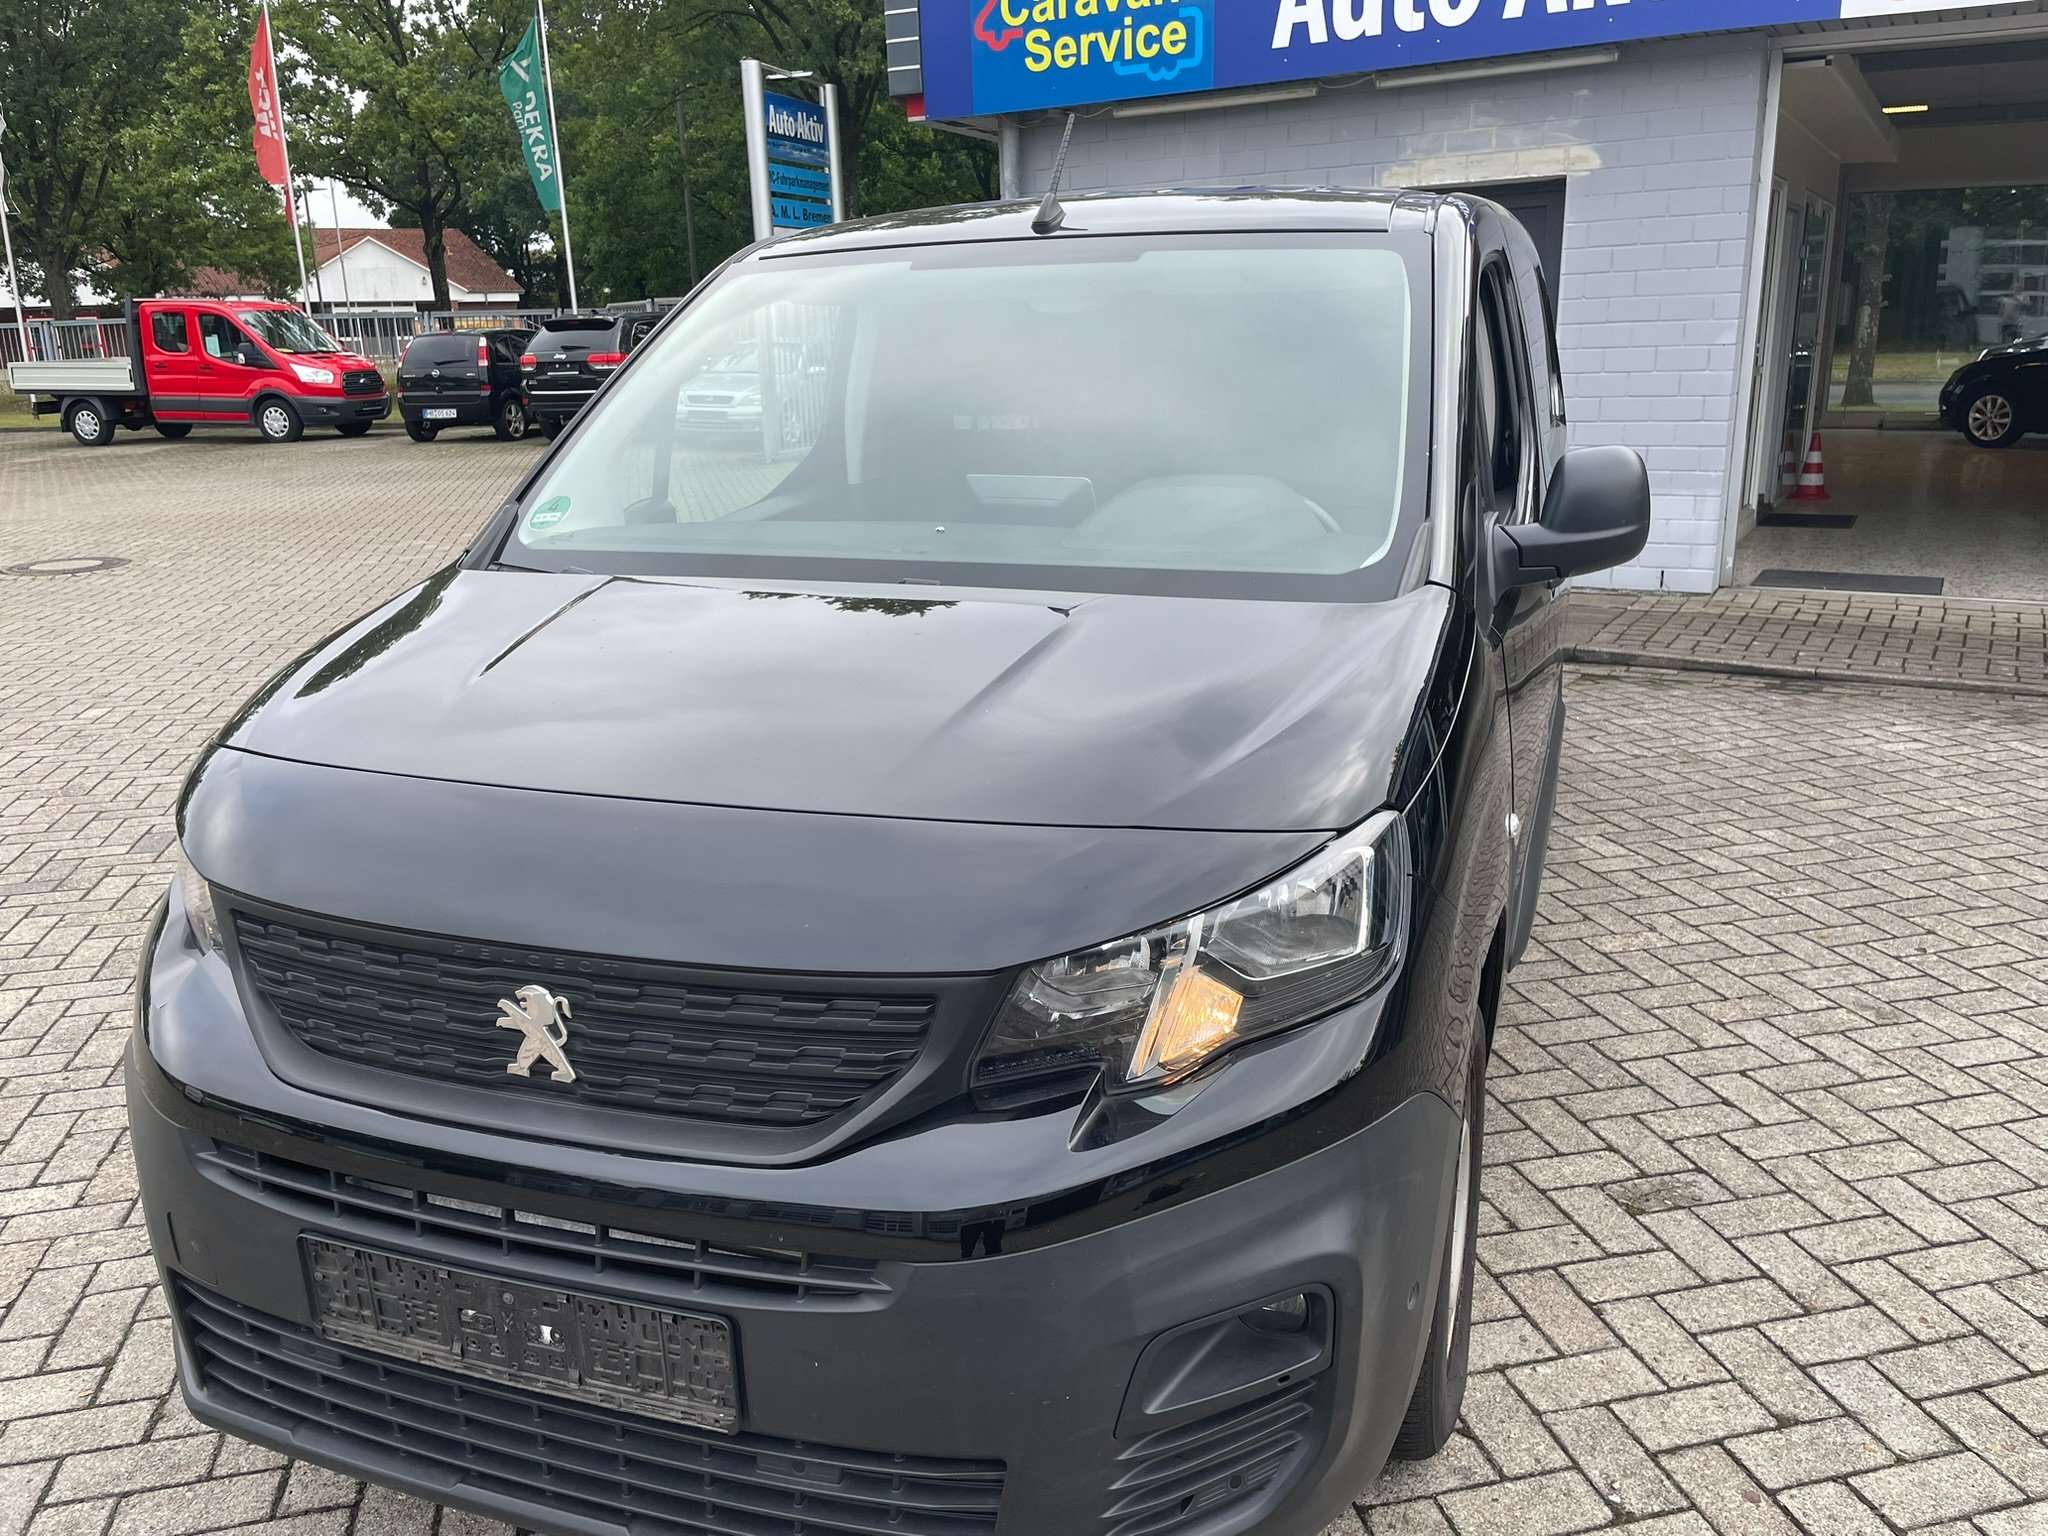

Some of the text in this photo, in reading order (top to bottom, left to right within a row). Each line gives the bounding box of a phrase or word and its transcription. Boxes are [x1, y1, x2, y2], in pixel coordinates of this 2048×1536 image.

[1000, 0, 1180, 26] Cara
[1024, 16, 1187, 72] Service
[769, 104, 824, 143] Auto Aktiv
